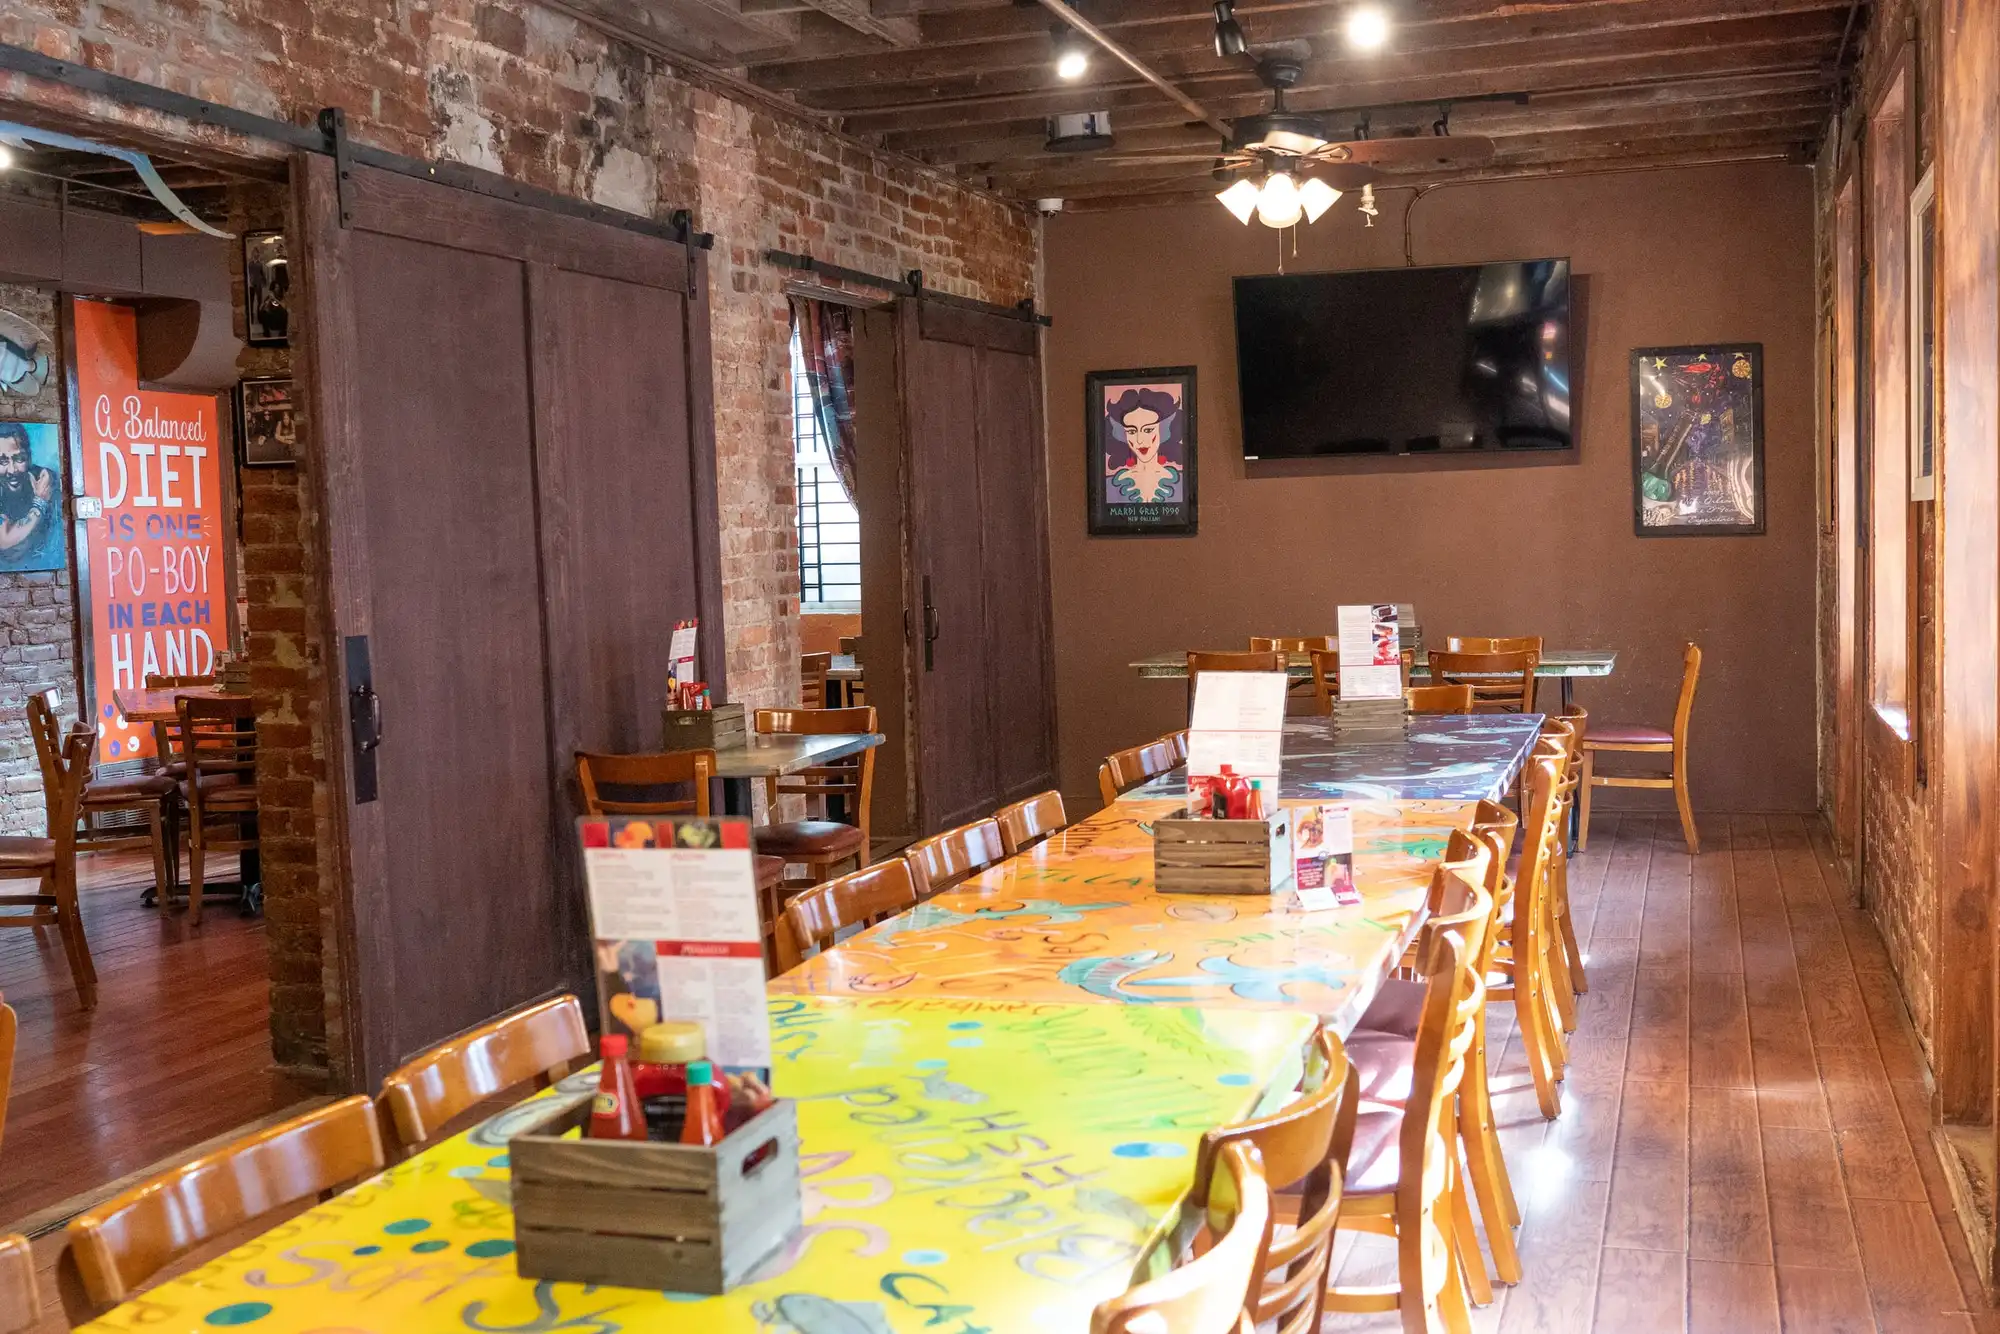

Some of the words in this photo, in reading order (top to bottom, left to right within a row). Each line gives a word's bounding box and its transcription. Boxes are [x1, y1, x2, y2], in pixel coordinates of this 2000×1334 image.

[94, 394, 120, 441] A
[122, 395, 207, 442] Balanced
[99, 441, 208, 509] DIET
[108, 513, 136, 542] IS
[145, 513, 202, 541] ONE
[1109, 507, 1136, 516] MARDI
[1139, 506, 1159, 516] GRAS
[106, 545, 210, 598] PO-BOY
[108, 602, 134, 630] IN
[141, 600, 210, 627] EACH
[110, 628, 213, 690] HAND
[950, 1111, 1110, 1190] FISH
